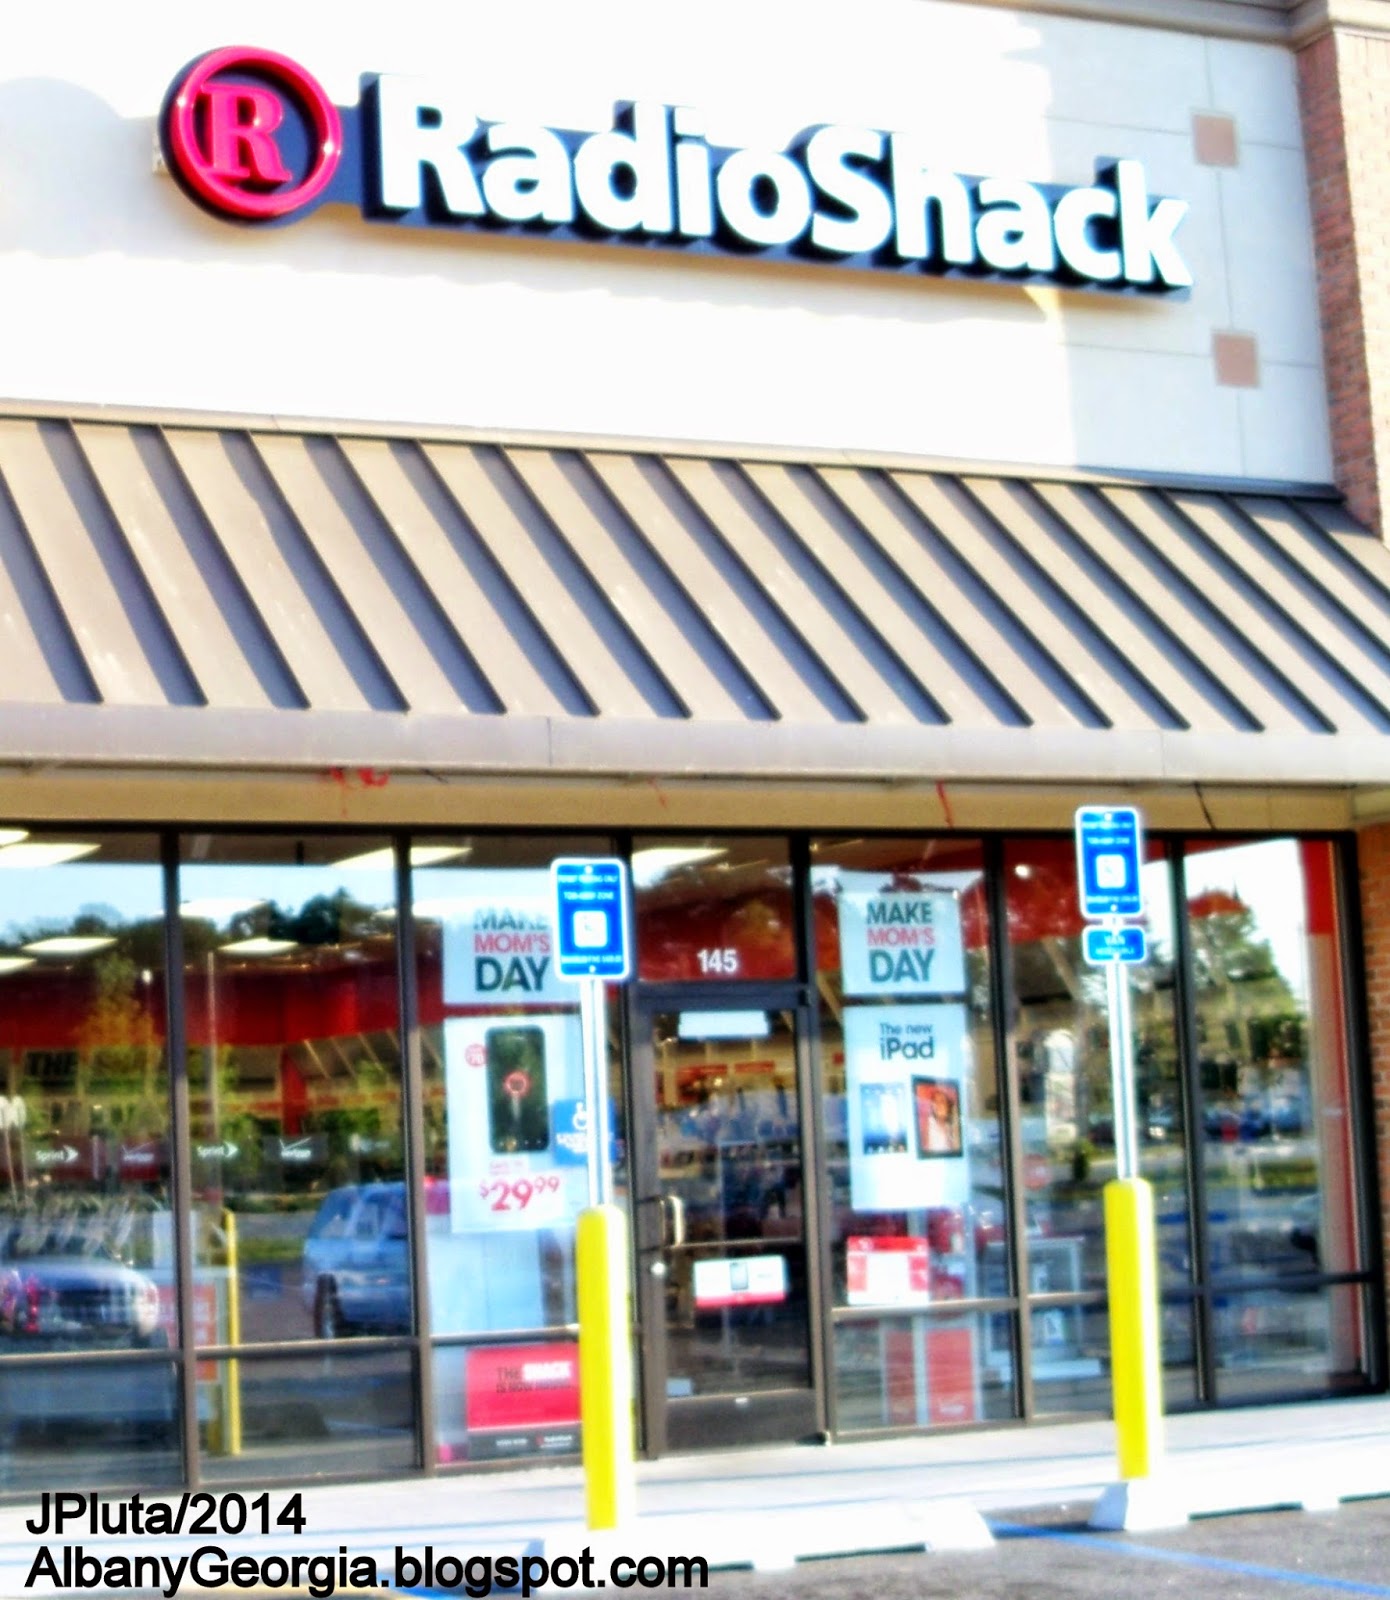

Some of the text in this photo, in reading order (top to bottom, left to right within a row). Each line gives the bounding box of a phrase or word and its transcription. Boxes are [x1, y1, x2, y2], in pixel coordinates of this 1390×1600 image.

[378, 73, 1193, 290] RadioShack
[867, 901, 933, 924] MAKE
[474, 933, 551, 954] MOM'S
[868, 928, 936, 945] MOM'S
[697, 950, 738, 973] 145
[869, 950, 935, 982] DAY
[475, 955, 551, 992] DAY
[879, 1022, 933, 1035] The new
[880, 1037, 935, 1060] iPad
